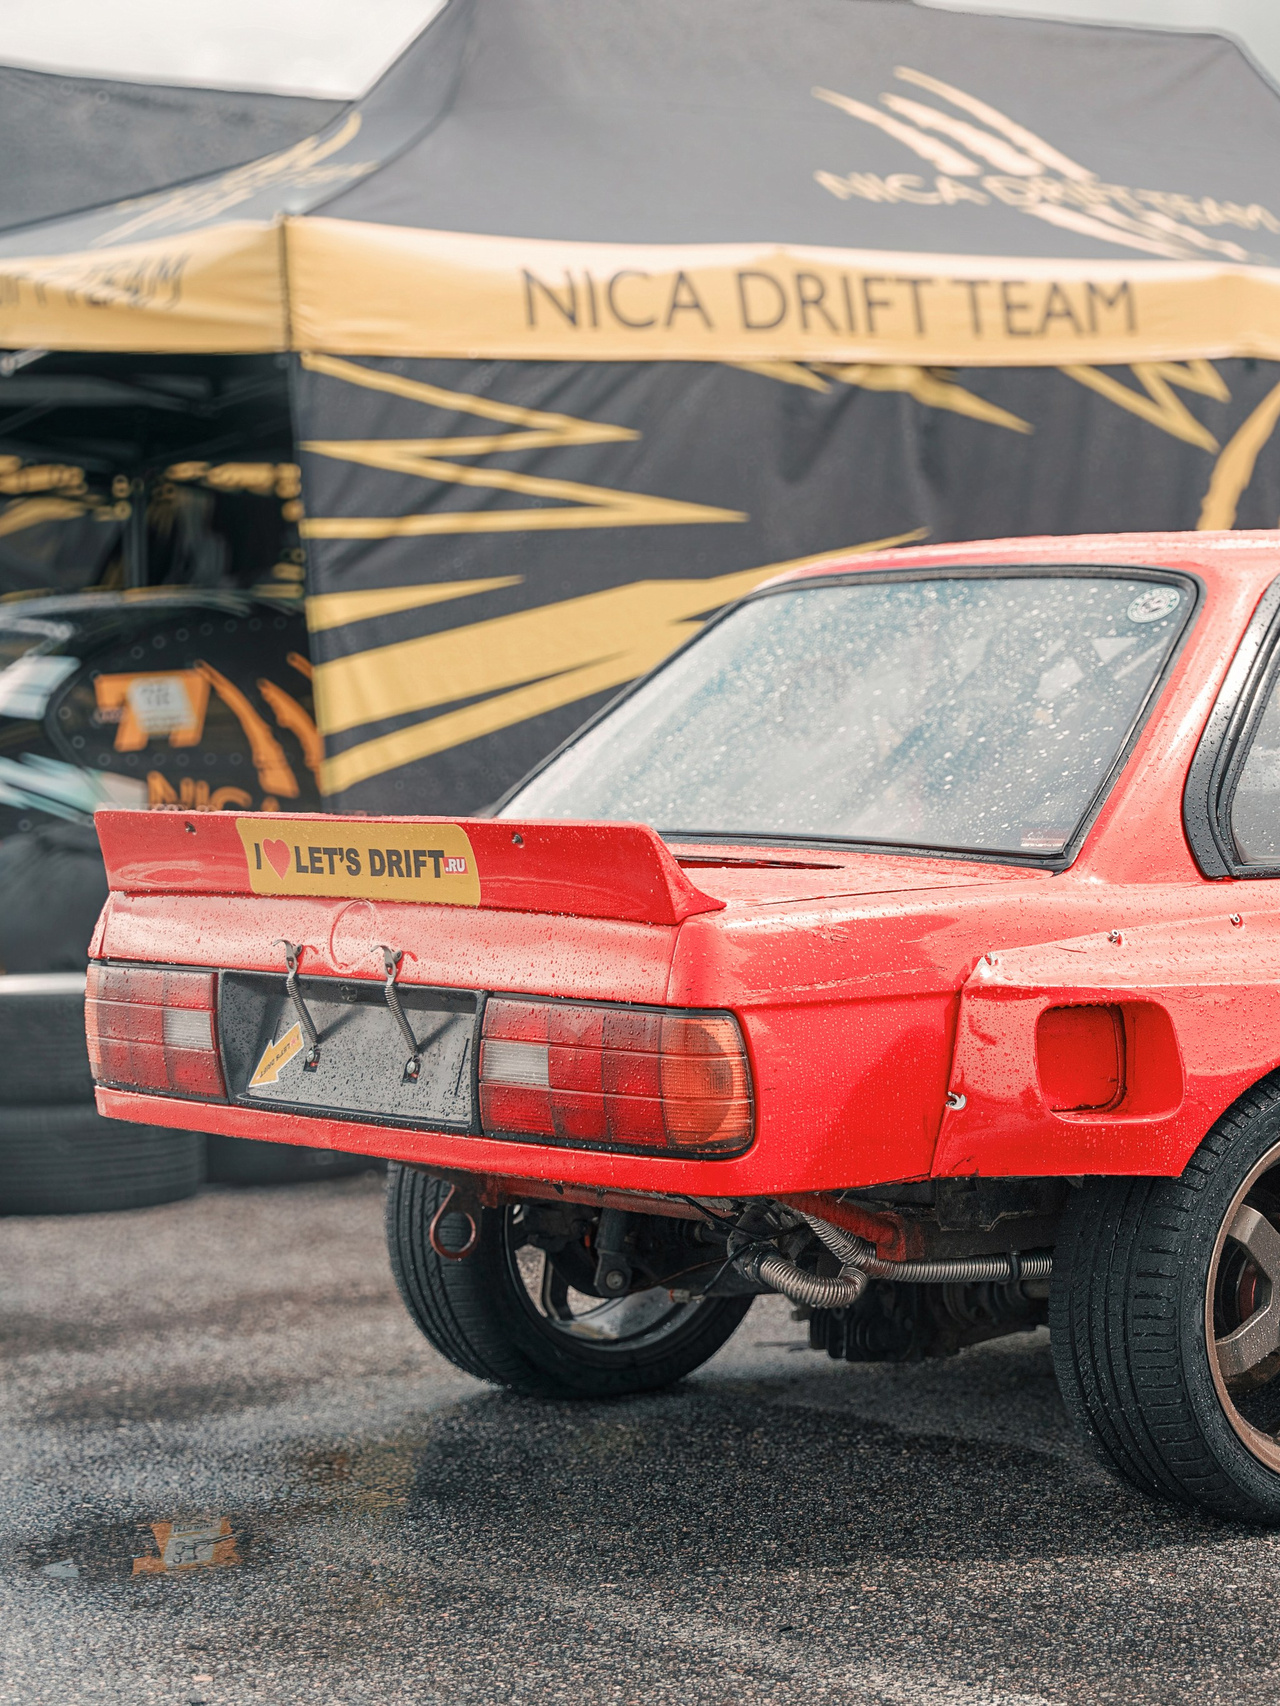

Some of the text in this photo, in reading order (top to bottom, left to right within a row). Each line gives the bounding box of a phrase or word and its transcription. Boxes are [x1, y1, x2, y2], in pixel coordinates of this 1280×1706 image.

[521, 268, 1142, 339] NICA DRIFT TEAM
[147, 770, 280, 812] NIC
[254, 842, 262, 870] I
[294, 845, 361, 877] LET'S
